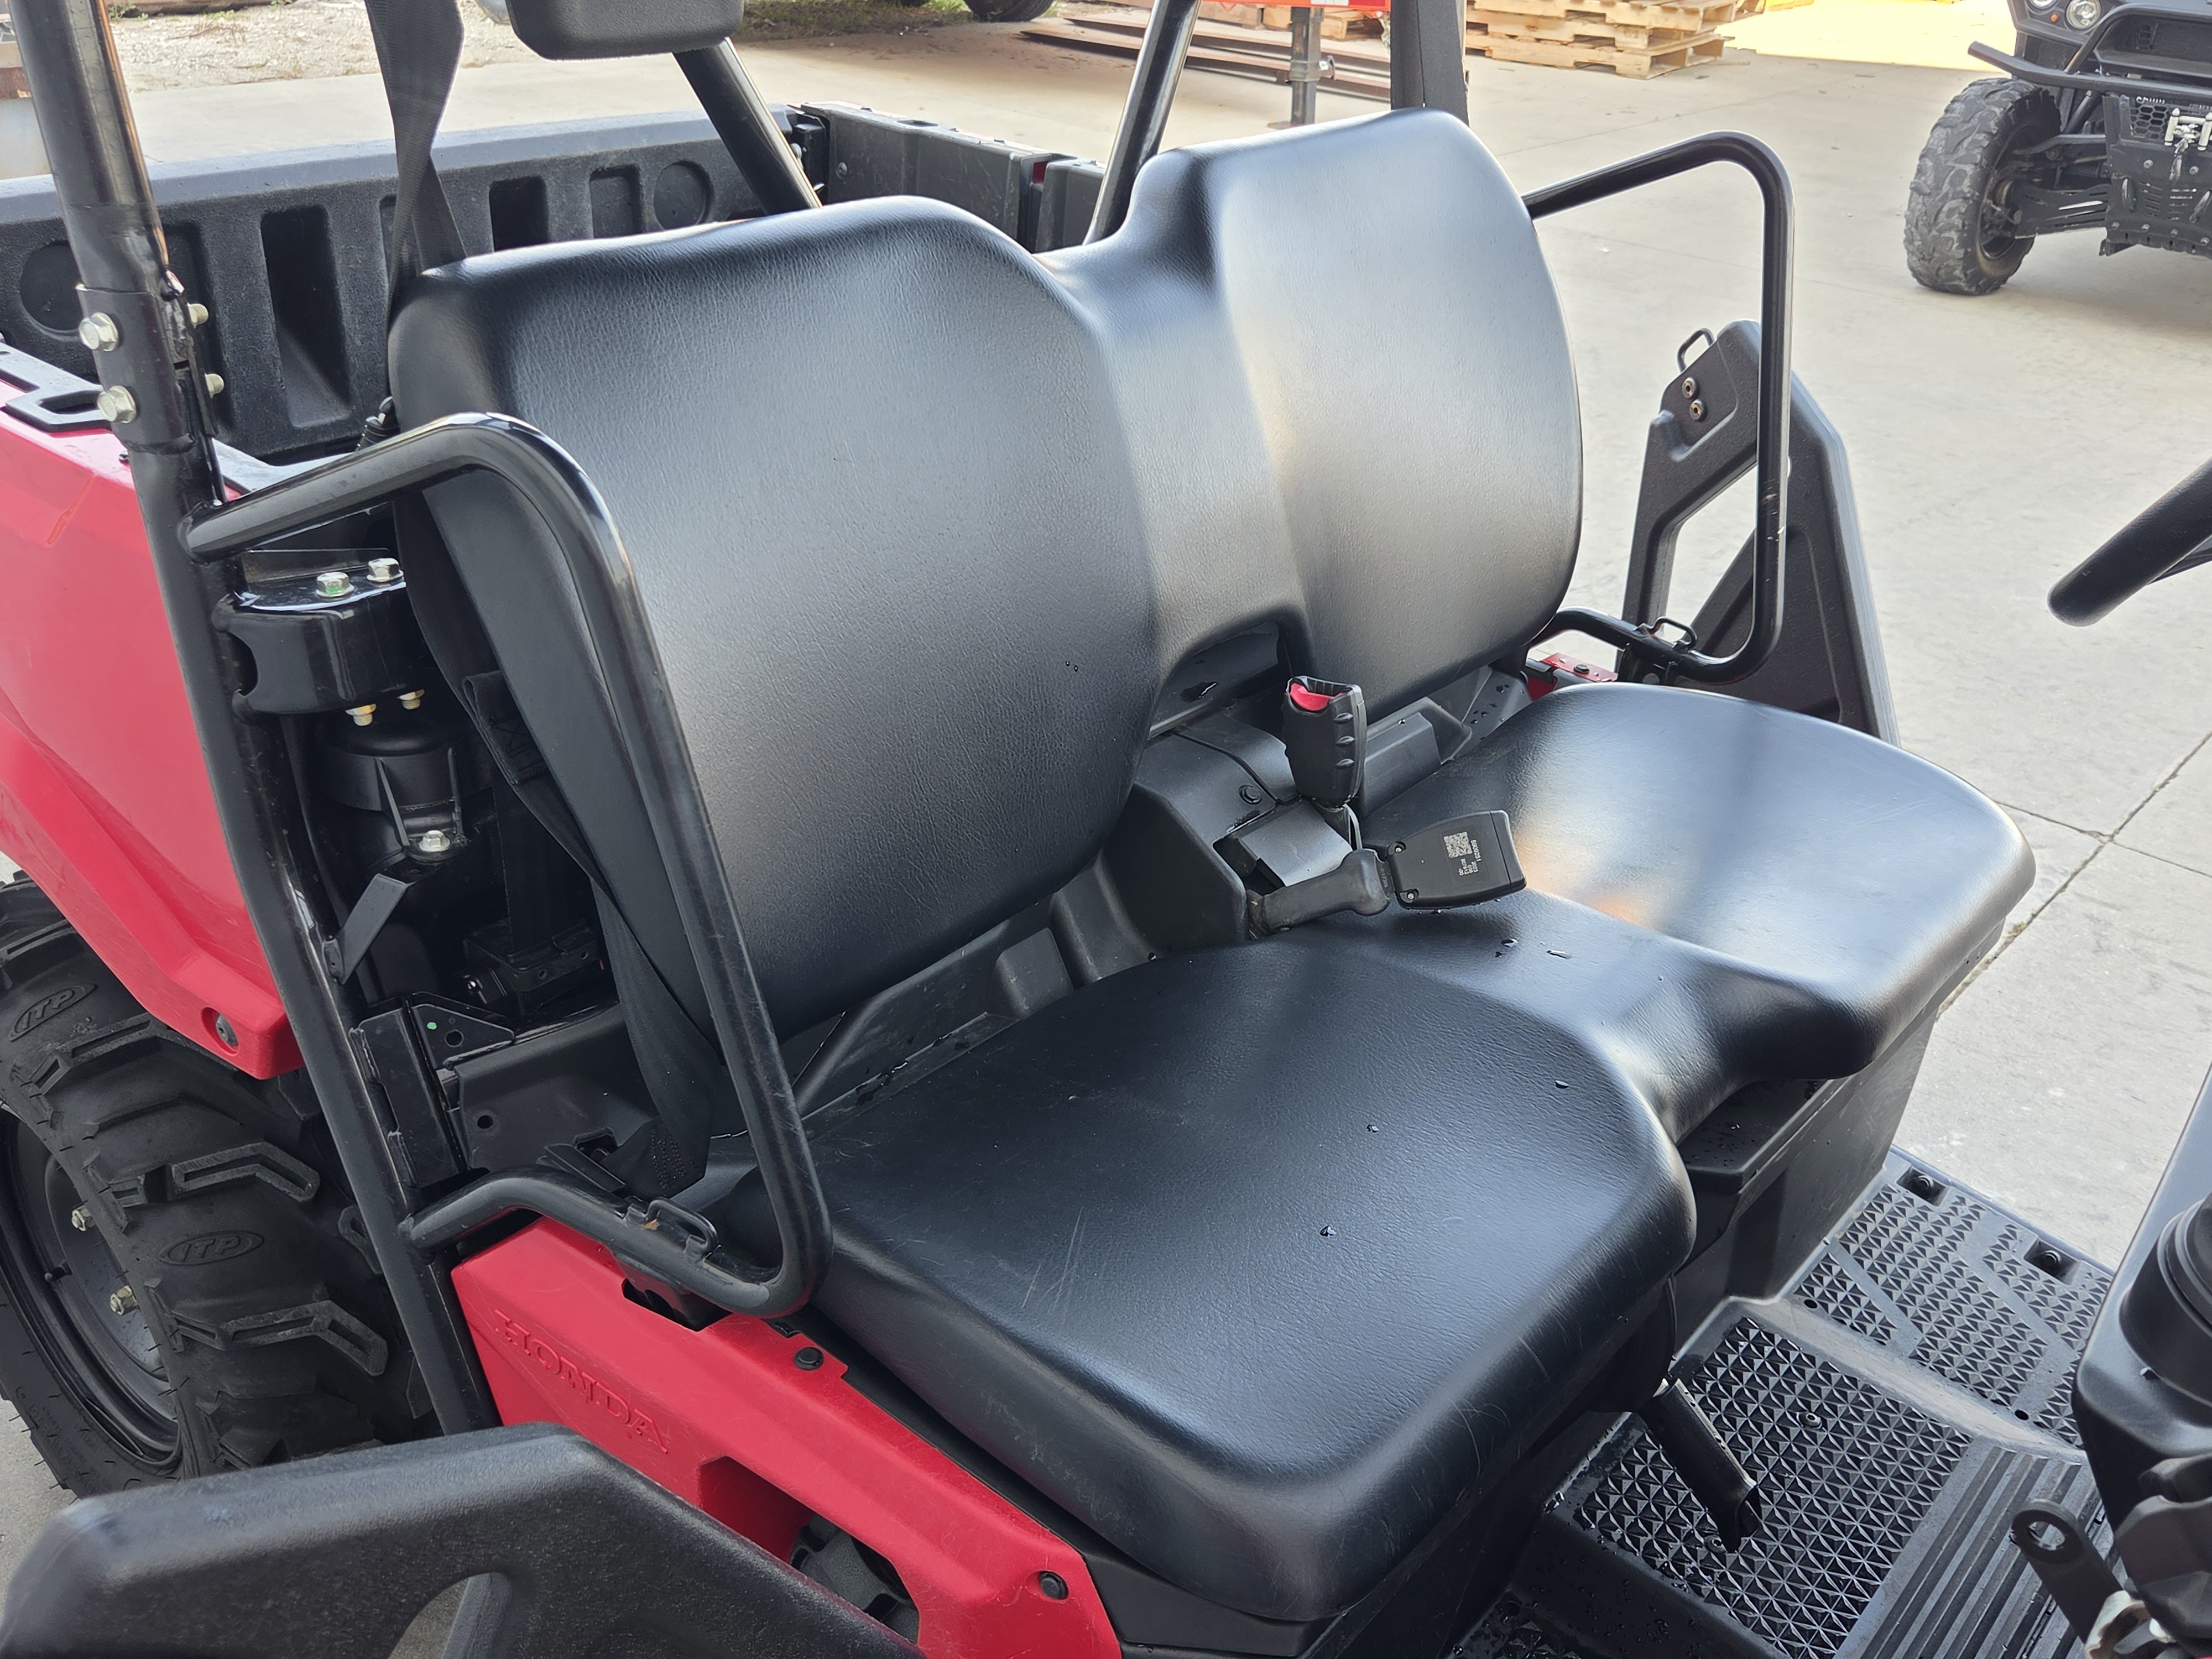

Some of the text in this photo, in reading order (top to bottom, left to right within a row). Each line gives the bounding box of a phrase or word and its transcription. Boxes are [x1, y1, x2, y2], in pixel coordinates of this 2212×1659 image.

[22, 989, 75, 1030] ITP
[176, 1235, 241, 1262] ITP
[495, 1309, 669, 1454] HONDA
